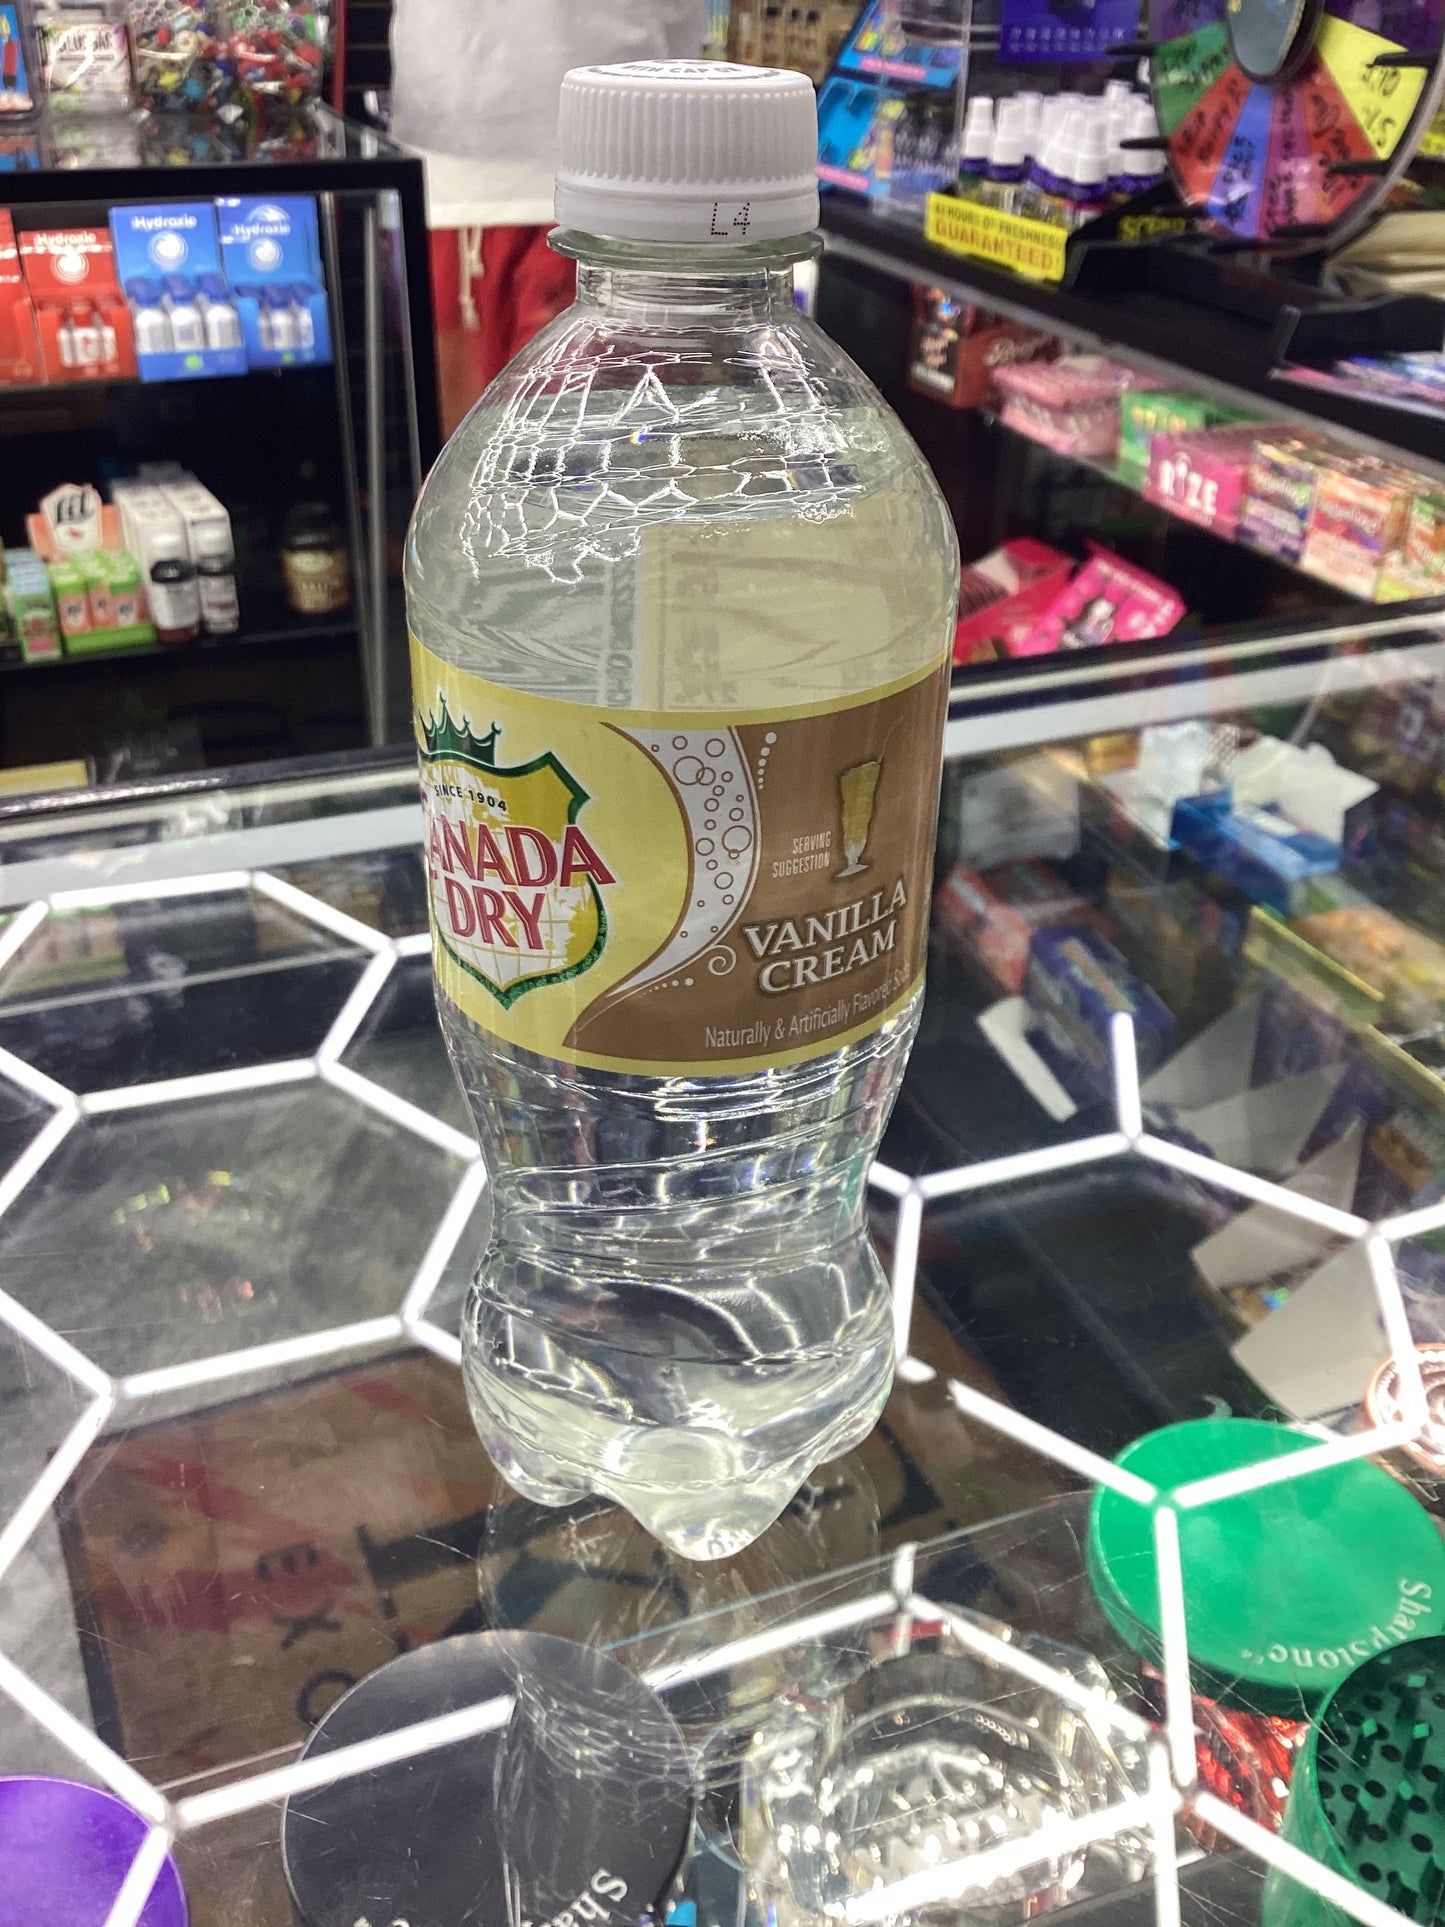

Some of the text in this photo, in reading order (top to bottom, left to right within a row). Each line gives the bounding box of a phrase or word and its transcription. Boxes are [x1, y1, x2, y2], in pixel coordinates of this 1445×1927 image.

[711, 202, 750, 235] L4
[434, 784, 509, 812] SINCE 1904
[423, 811, 617, 888] ANADA
[771, 852, 831, 879] SUGGESTION
[792, 830, 832, 855] SERVING
[444, 875, 546, 951] DRY
[744, 880, 908, 959] VANILLA
[760, 920, 897, 994] CREAM
[704, 1020, 772, 1048] Naturally
[774, 1017, 786, 1041] &
[788, 1000, 851, 1037] Artificially
[852, 982, 893, 1016] Flavored
